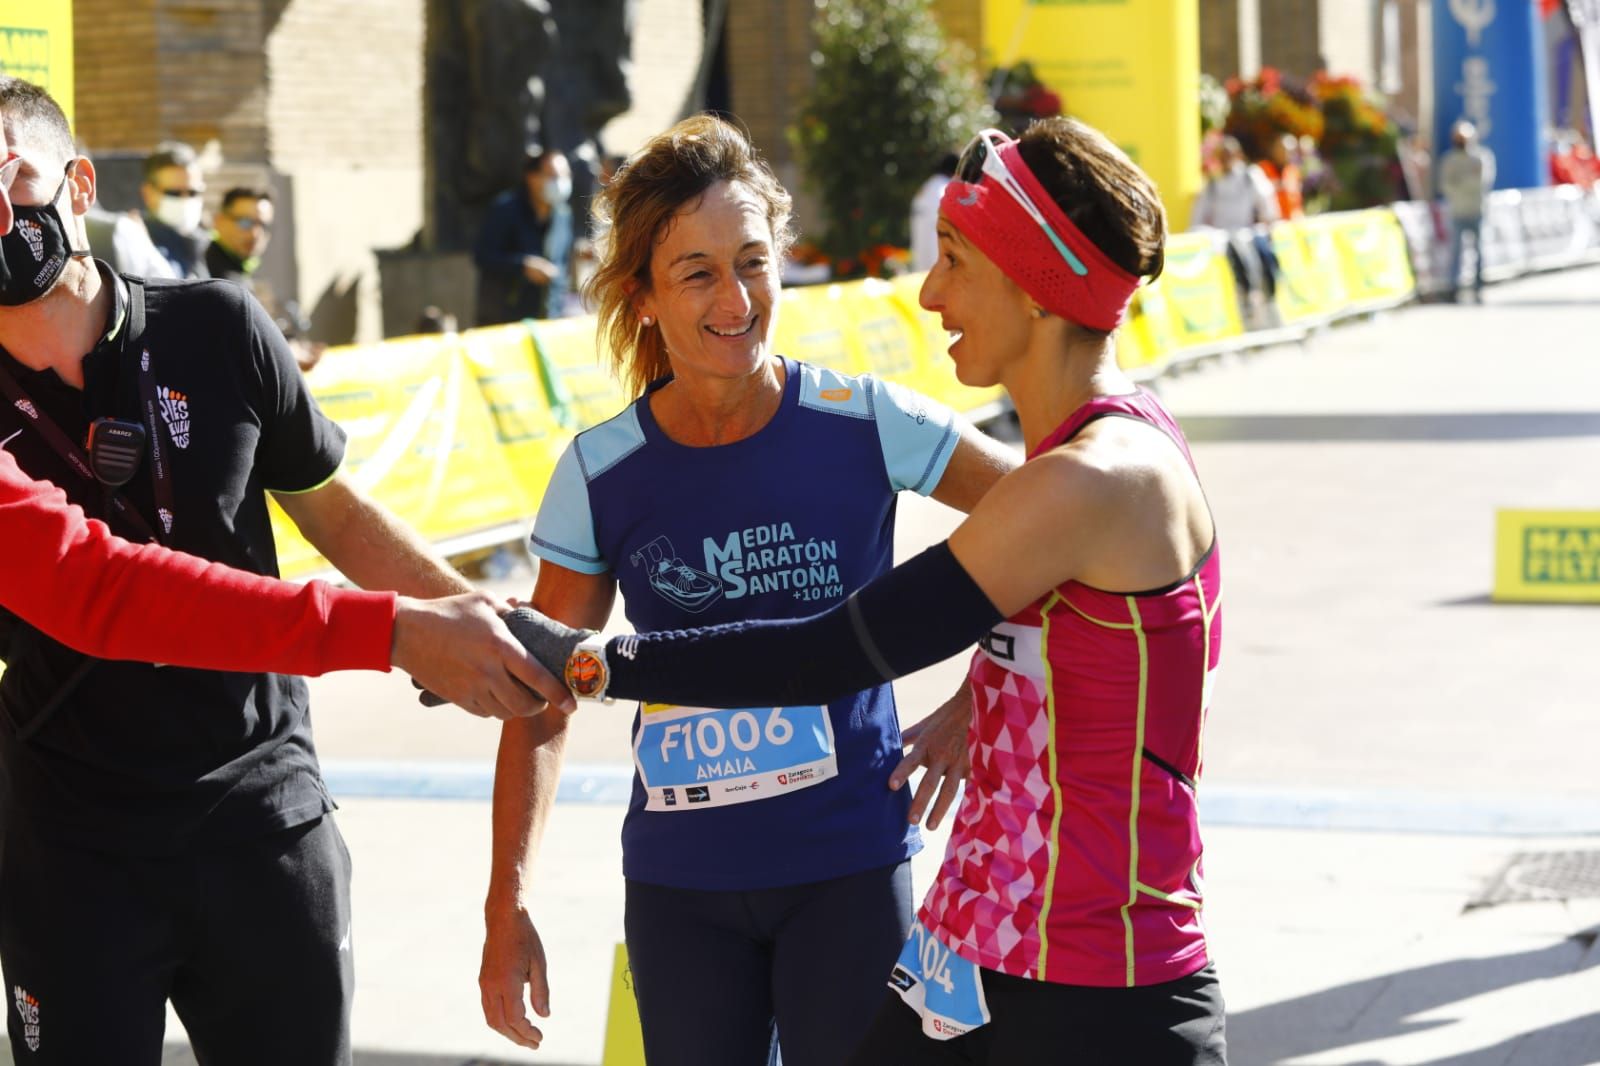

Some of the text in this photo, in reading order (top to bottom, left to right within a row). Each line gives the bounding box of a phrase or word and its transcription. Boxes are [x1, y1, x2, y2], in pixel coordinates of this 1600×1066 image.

[159, 400, 189, 424] PIES
[168, 420, 190, 436] EVEN
[171, 433, 190, 449] TOS
[720, 560, 840, 599] SANTOÑA
[824, 584, 843, 599] KM
[661, 707, 794, 763] F1006
[696, 756, 757, 780] AMAIA
